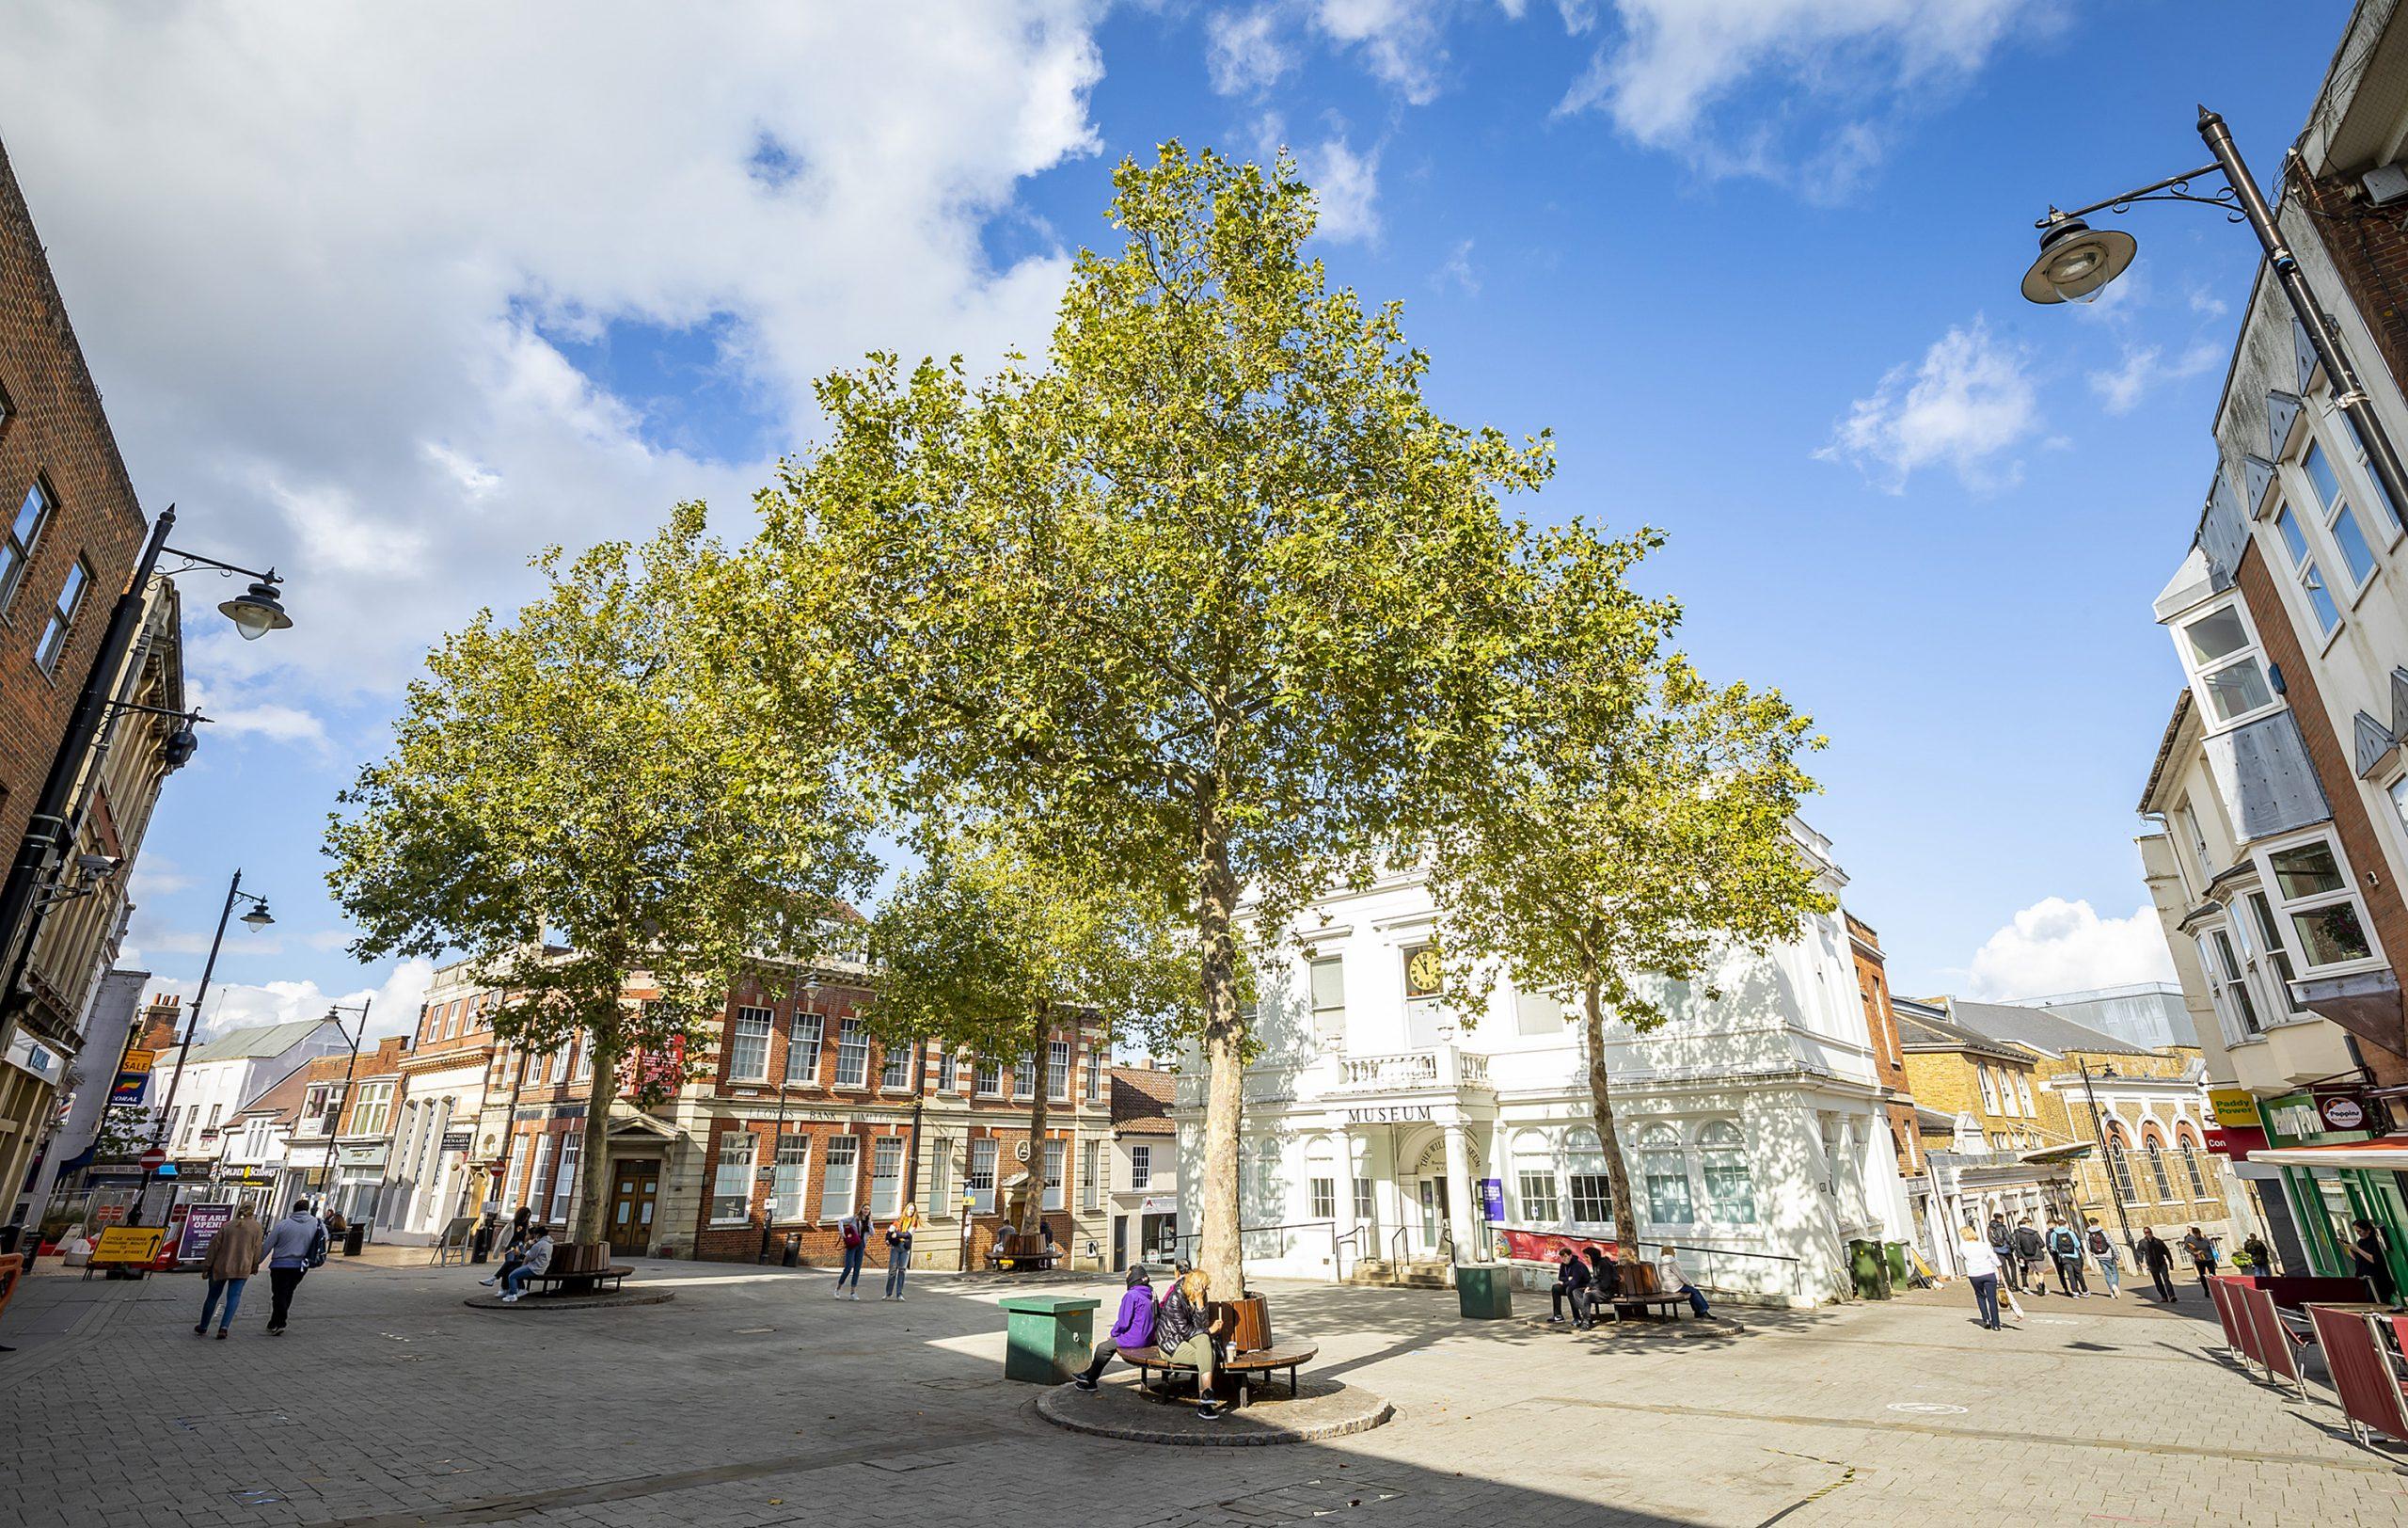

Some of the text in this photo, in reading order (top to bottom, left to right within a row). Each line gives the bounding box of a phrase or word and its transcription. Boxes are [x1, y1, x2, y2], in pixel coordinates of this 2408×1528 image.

[123, 1062, 148, 1071] SALE
[2216, 1099, 2249, 1107] Paddy
[809, 1110, 837, 1121] BANK
[850, 1112, 893, 1122] LIMITED
[1348, 1106, 1432, 1123] MUSEUM
[1419, 1150, 1432, 1168] THE
[1465, 1143, 1482, 1168] SEUM
